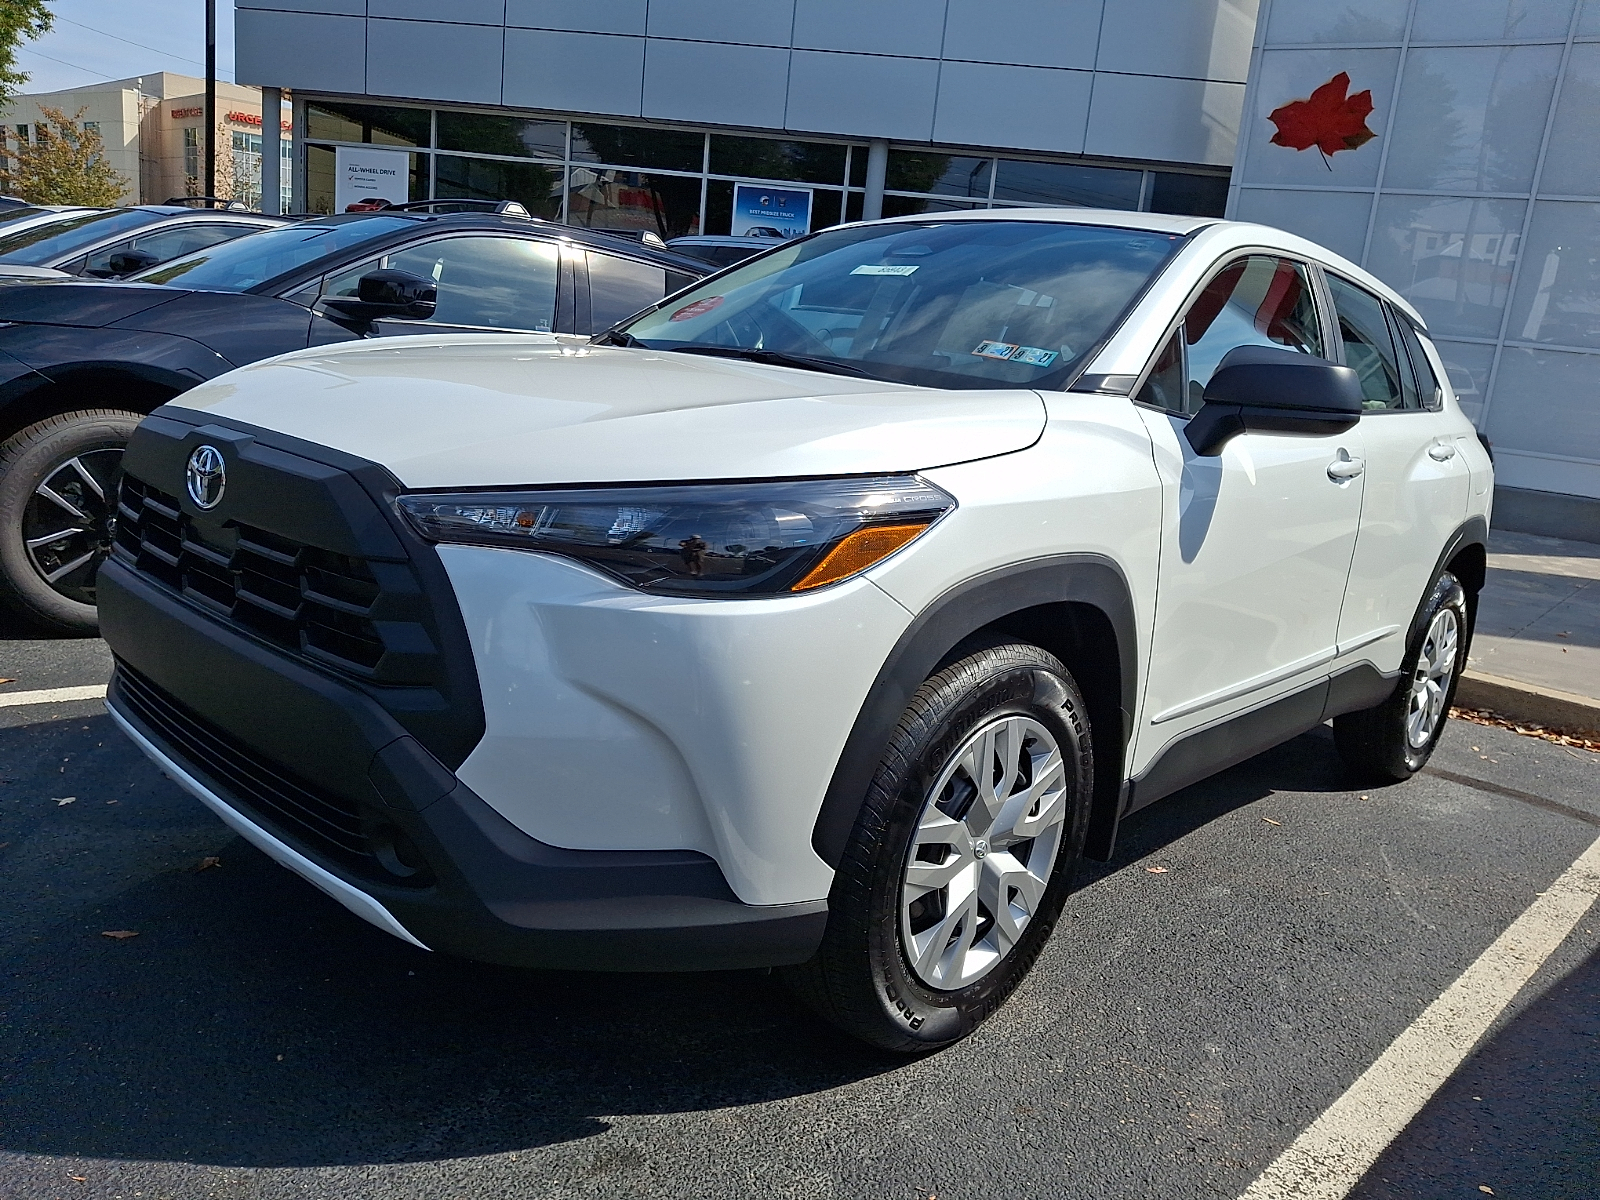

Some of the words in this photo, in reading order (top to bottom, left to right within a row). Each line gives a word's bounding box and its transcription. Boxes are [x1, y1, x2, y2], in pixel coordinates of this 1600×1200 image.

[228, 111, 262, 125] URGE
[348, 166, 379, 174] ALL-WHEEL
[903, 494, 942, 503] CROSS
